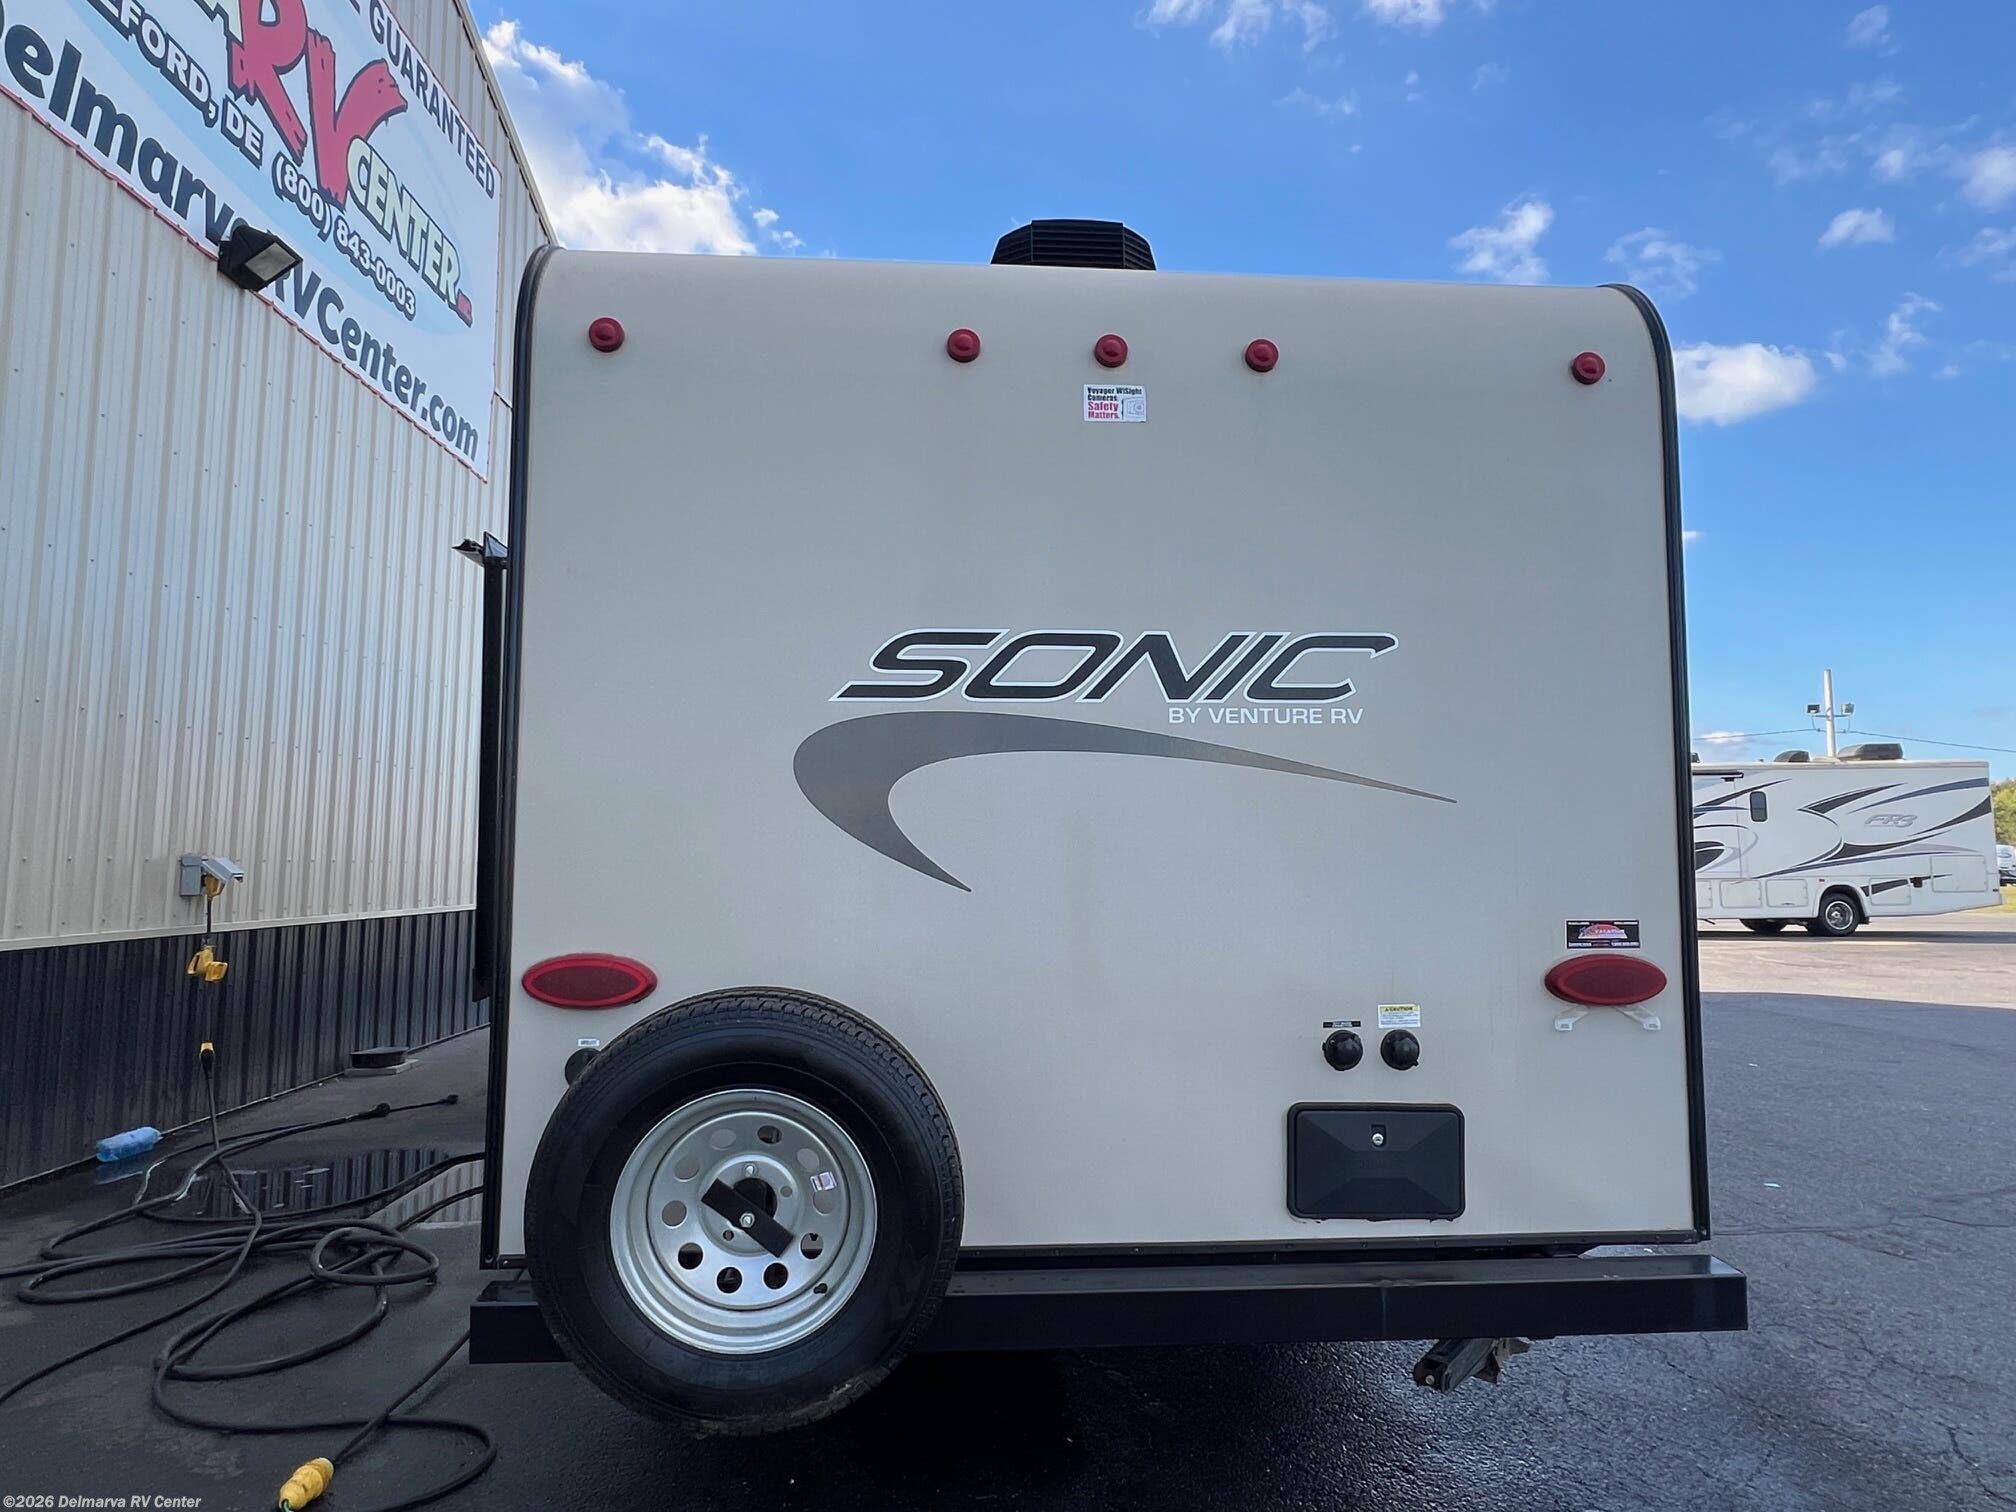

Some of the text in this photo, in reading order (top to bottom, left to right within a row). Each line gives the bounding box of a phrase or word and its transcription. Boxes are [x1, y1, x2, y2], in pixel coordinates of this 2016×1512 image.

[228, 0, 408, 213] RV
[369, 0, 494, 199] GUARANTEED
[221, 95, 264, 170] DE
[271, 151, 333, 242] (800)
[333, 214, 417, 321] 843-0003
[1087, 387, 1115, 395] Voyager
[1088, 402, 1119, 411] Safety
[828, 627, 1399, 703] SONIC
[1168, 707, 1364, 725] BY VENTURE RV
